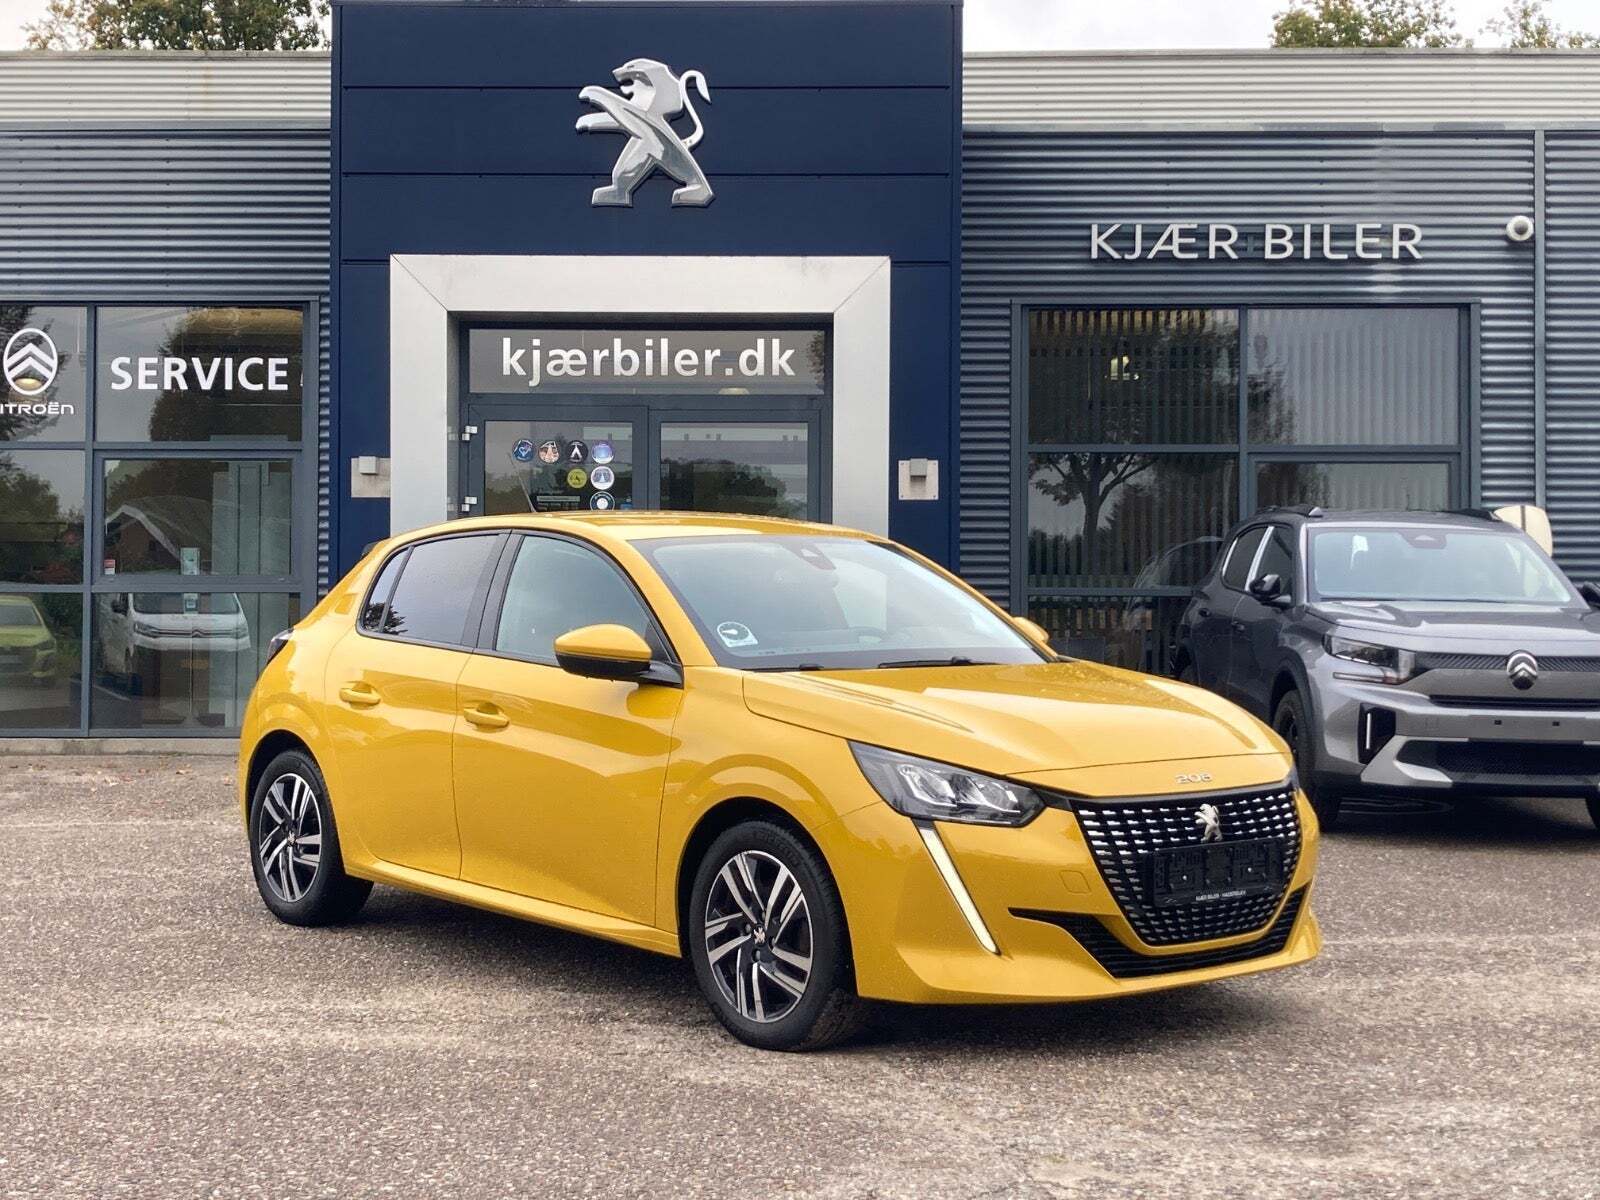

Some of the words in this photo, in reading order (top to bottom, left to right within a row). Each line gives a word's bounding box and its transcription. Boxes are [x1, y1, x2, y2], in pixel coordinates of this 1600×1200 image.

[1090, 223, 1240, 260] KJÆR
[1264, 223, 1423, 260] BILER
[110, 357, 288, 390] SERVICE
[502, 337, 796, 387] kjærbiler.dk
